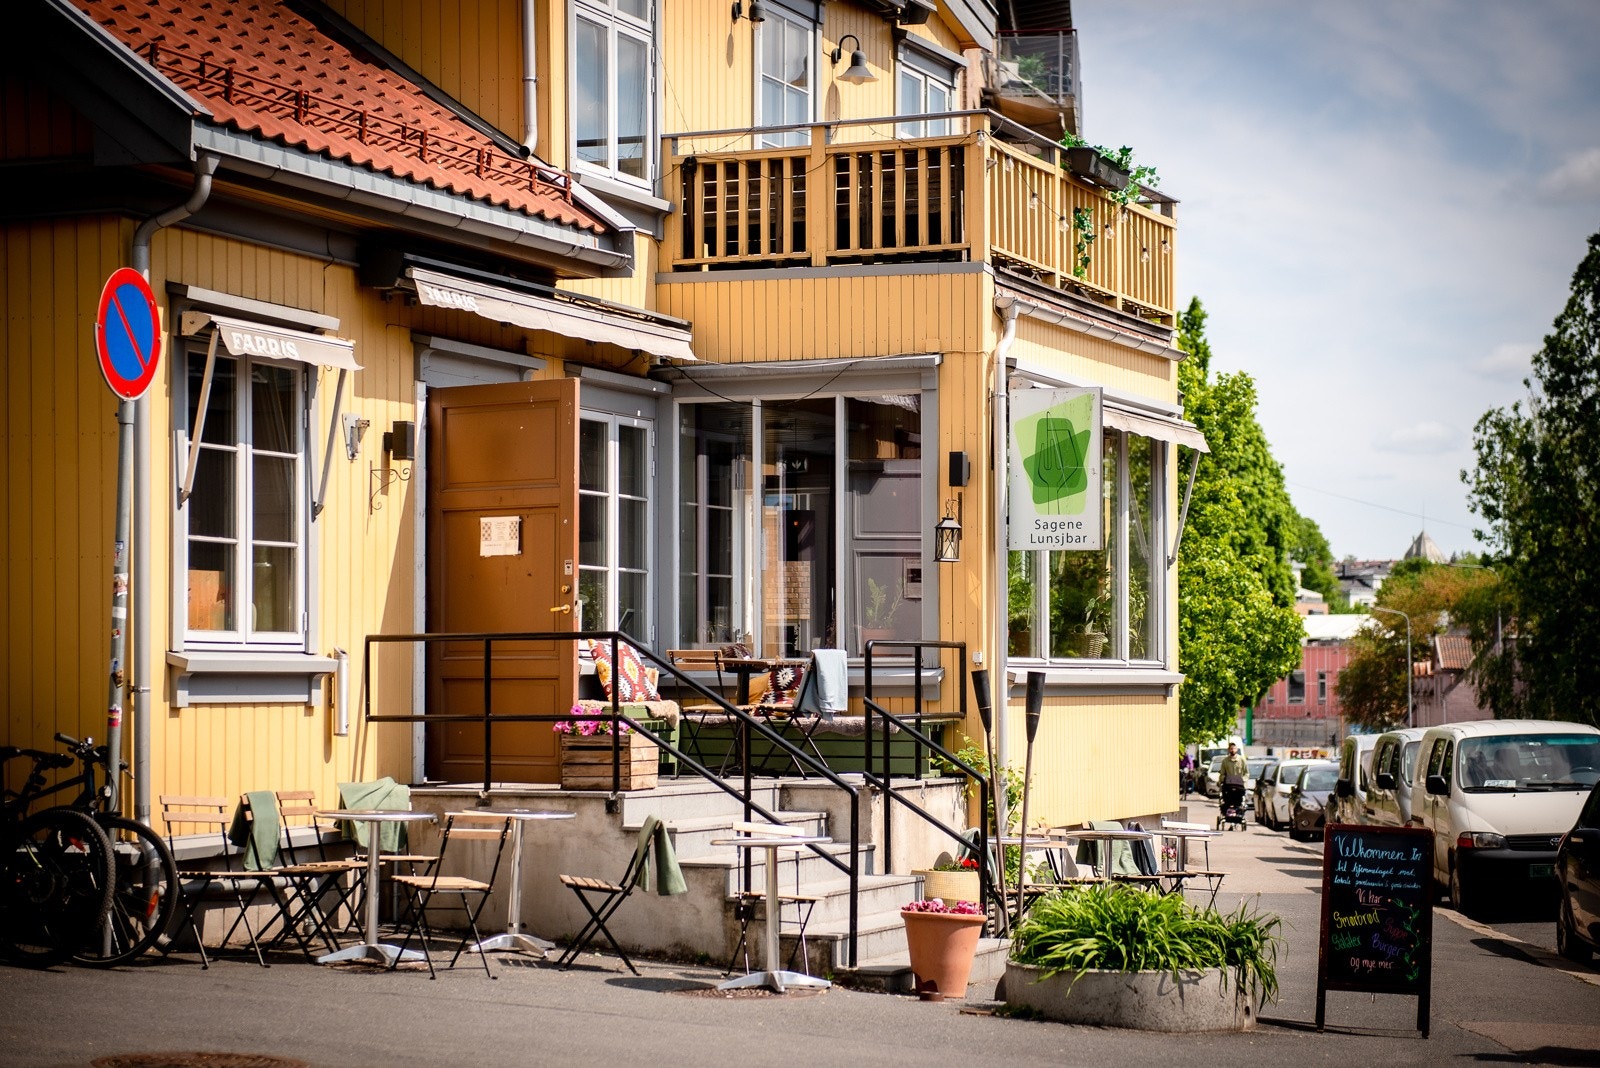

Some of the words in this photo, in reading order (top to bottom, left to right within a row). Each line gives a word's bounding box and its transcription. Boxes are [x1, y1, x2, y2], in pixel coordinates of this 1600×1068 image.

[231, 331, 301, 360] FARRIS
[1034, 519, 1083, 532] Sagene
[1030, 533, 1088, 546] Lunsjbar
[1334, 835, 1407, 861] Velkommen
[1355, 888, 1366, 903] Vi
[1368, 889, 1383, 904] har
[1371, 932, 1406, 960] Burger
[1362, 958, 1377, 974] mye
[1378, 961, 1395, 970] mer
